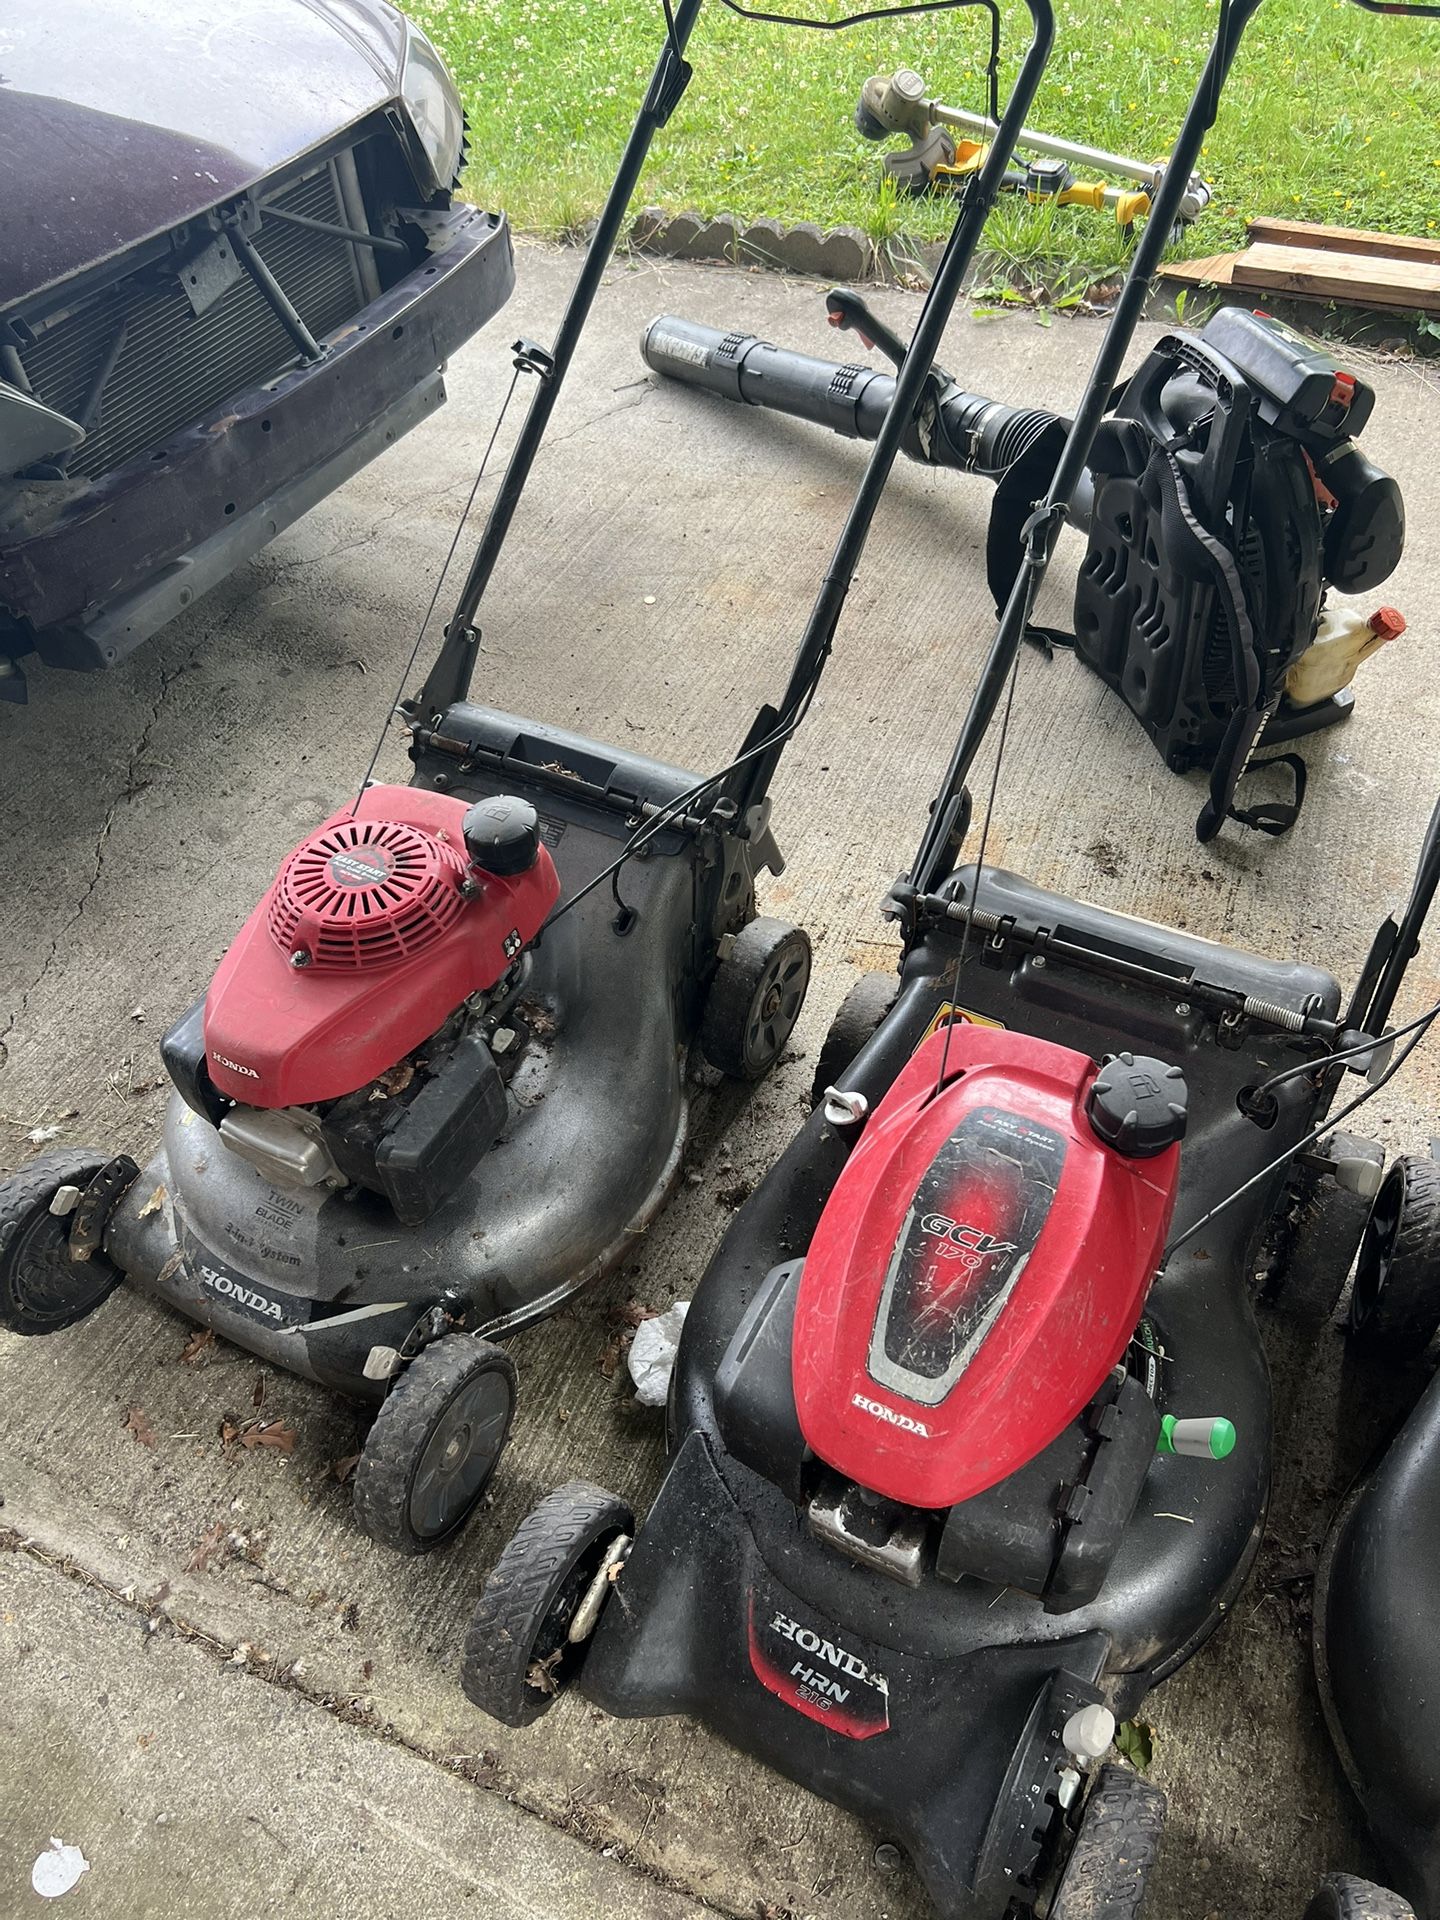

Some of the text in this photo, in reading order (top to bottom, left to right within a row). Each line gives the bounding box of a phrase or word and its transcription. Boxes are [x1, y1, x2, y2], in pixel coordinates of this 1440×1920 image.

[334, 855, 359, 866] EASY
[357, 864, 387, 877] START
[212, 1051, 260, 1079] HONDA
[267, 1190, 306, 1215] TWIN
[255, 1207, 294, 1230] BLADE
[921, 1213, 1018, 1254] GCV
[258, 1241, 302, 1267] ystem
[934, 1242, 983, 1269] 170
[200, 1265, 283, 1321] HONDA
[851, 1393, 929, 1438] HONDA
[769, 1611, 889, 1696] HONDA
[790, 1662, 850, 1704] HRN
[795, 1685, 832, 1711] 216
[1051, 1730, 1060, 1739] 2
[1031, 1784, 1041, 1794] 3
[1004, 1867, 1013, 1875] 4
